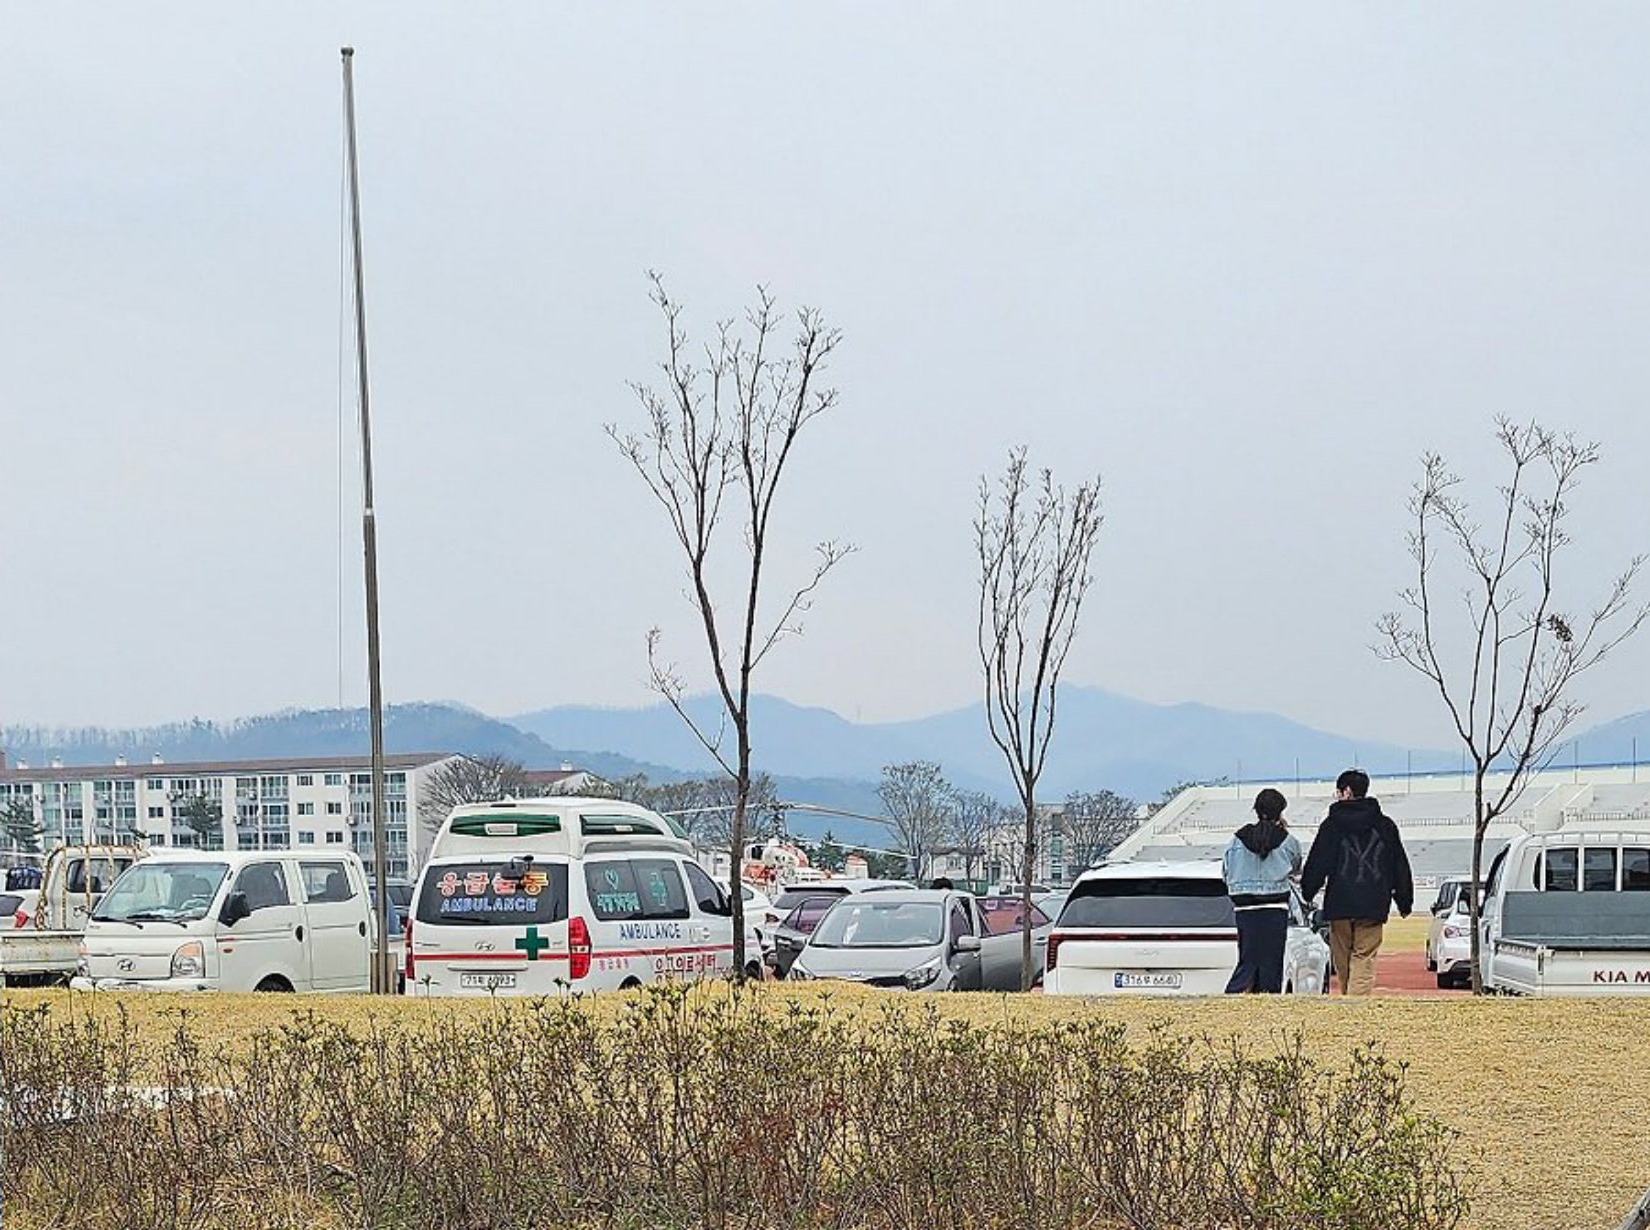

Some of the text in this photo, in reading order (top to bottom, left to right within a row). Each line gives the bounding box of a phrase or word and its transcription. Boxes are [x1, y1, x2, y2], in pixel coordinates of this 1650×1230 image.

[440, 897, 538, 913] AMBULANCE
[619, 923, 681, 940] AMBULANCE
[1593, 970, 1629, 983] KIA
